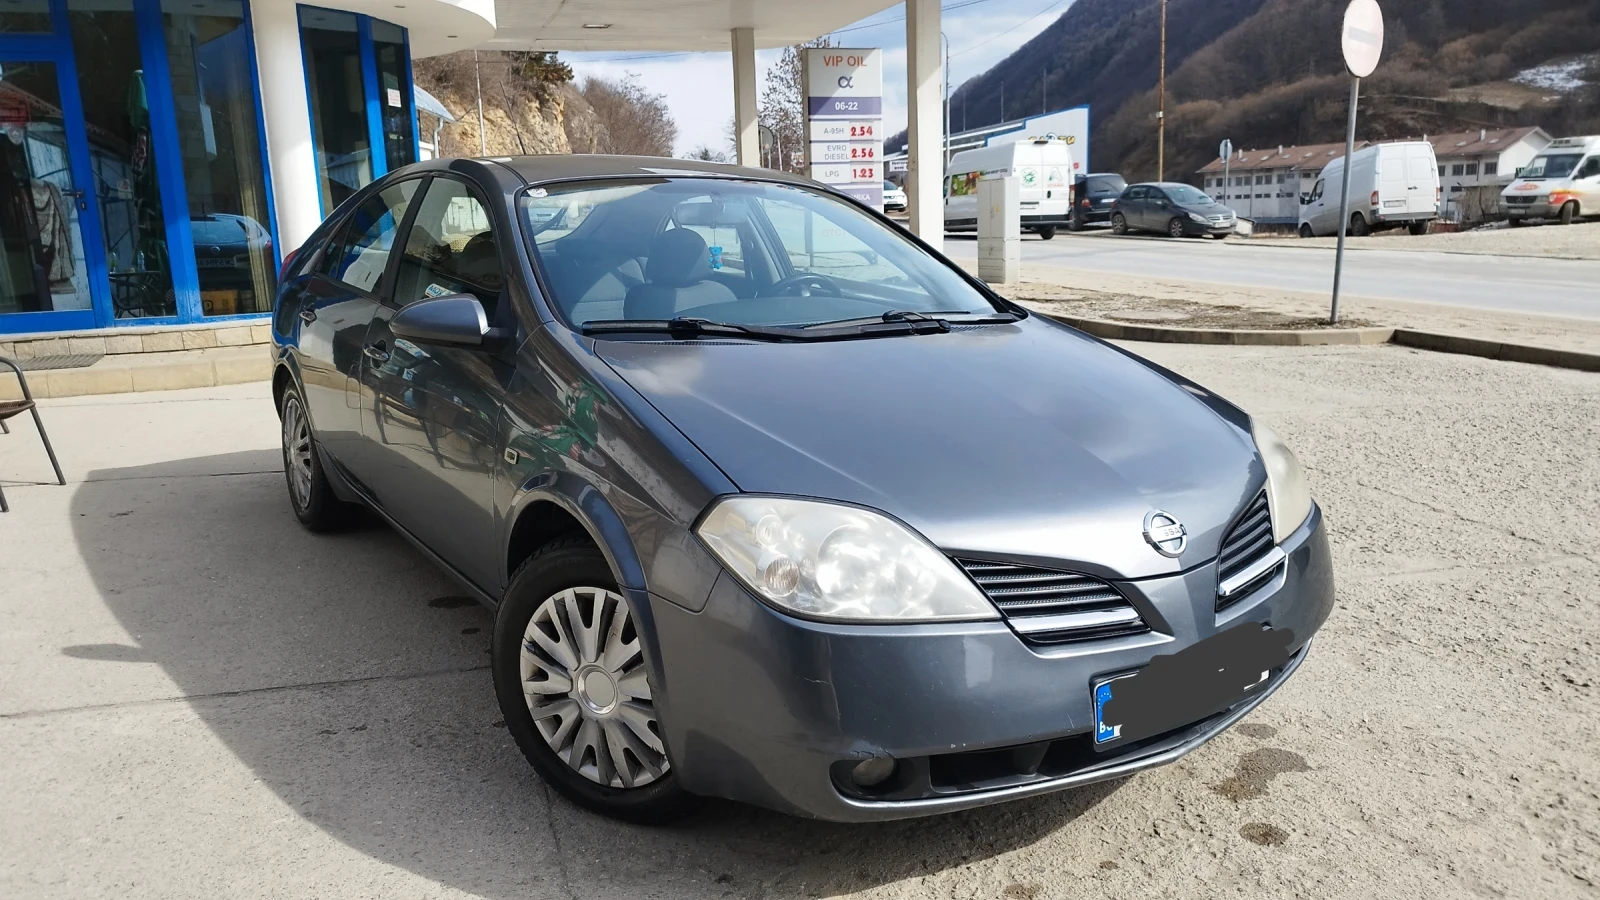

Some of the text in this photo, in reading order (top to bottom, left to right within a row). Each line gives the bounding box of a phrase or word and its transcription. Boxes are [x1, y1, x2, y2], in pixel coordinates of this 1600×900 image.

[823, 55, 868, 67] VIP OIL
[834, 101, 859, 111] 06-22
[850, 126, 873, 137] 2.54
[851, 148, 874, 158] 2.56
[853, 168, 874, 179] 1.23
